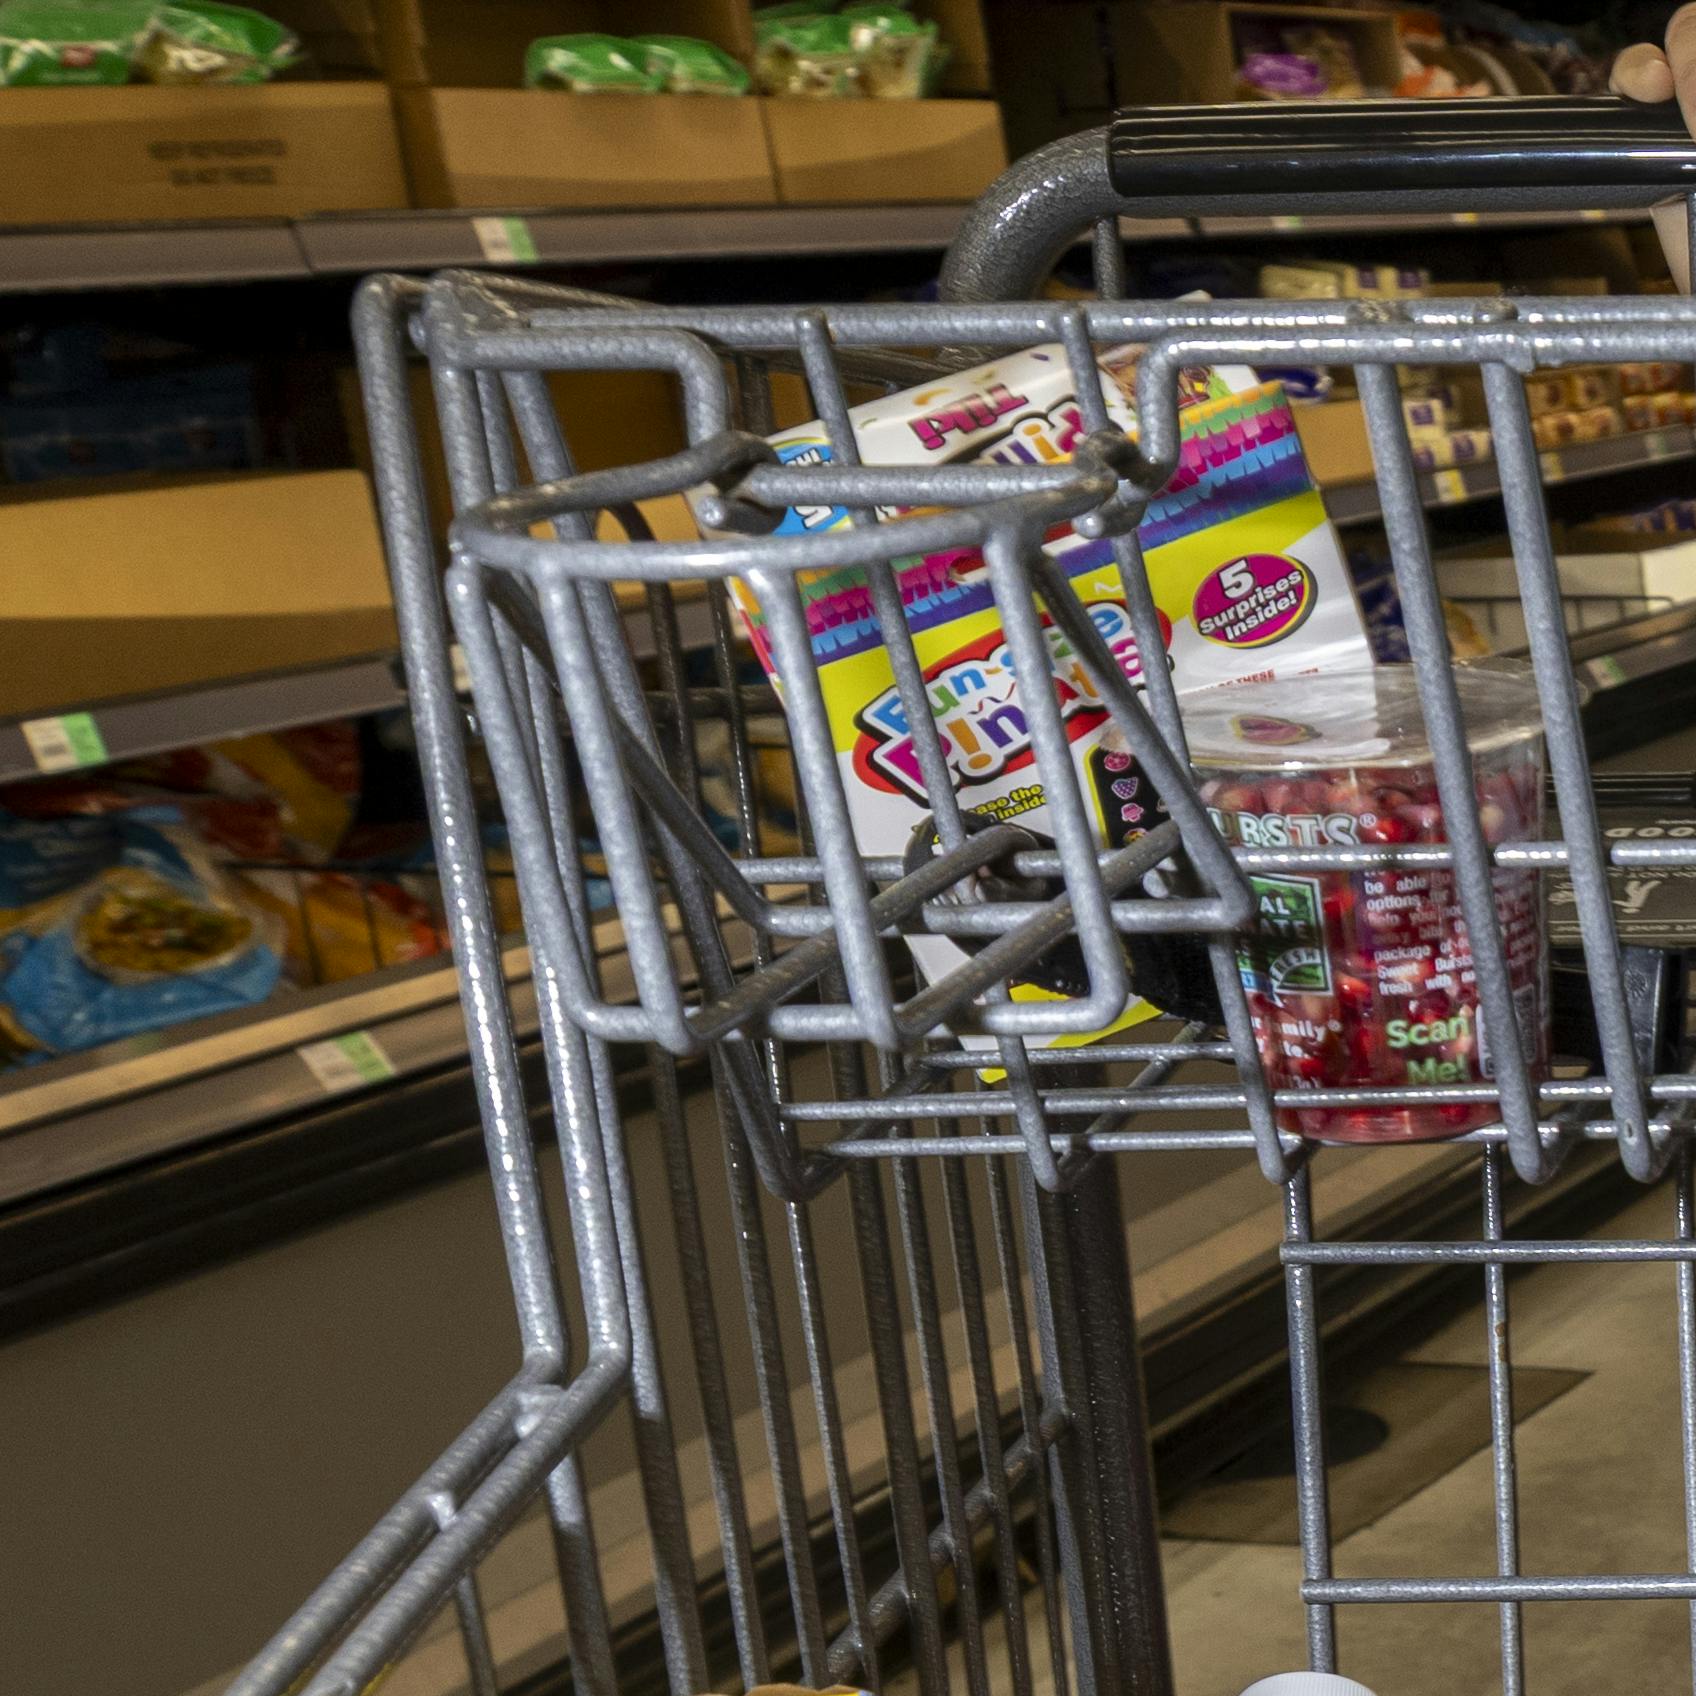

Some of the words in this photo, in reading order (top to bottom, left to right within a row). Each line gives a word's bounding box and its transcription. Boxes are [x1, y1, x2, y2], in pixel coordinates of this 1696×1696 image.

[1219, 558, 1254, 600] 5
[1225, 591, 1297, 642] Inside!
[1373, 944, 1432, 964] package
[1379, 978, 1413, 995] fresh
[1425, 971, 1450, 991] with
[1386, 1016, 1470, 1049] Scan
[1407, 1055, 1470, 1086] Me!
